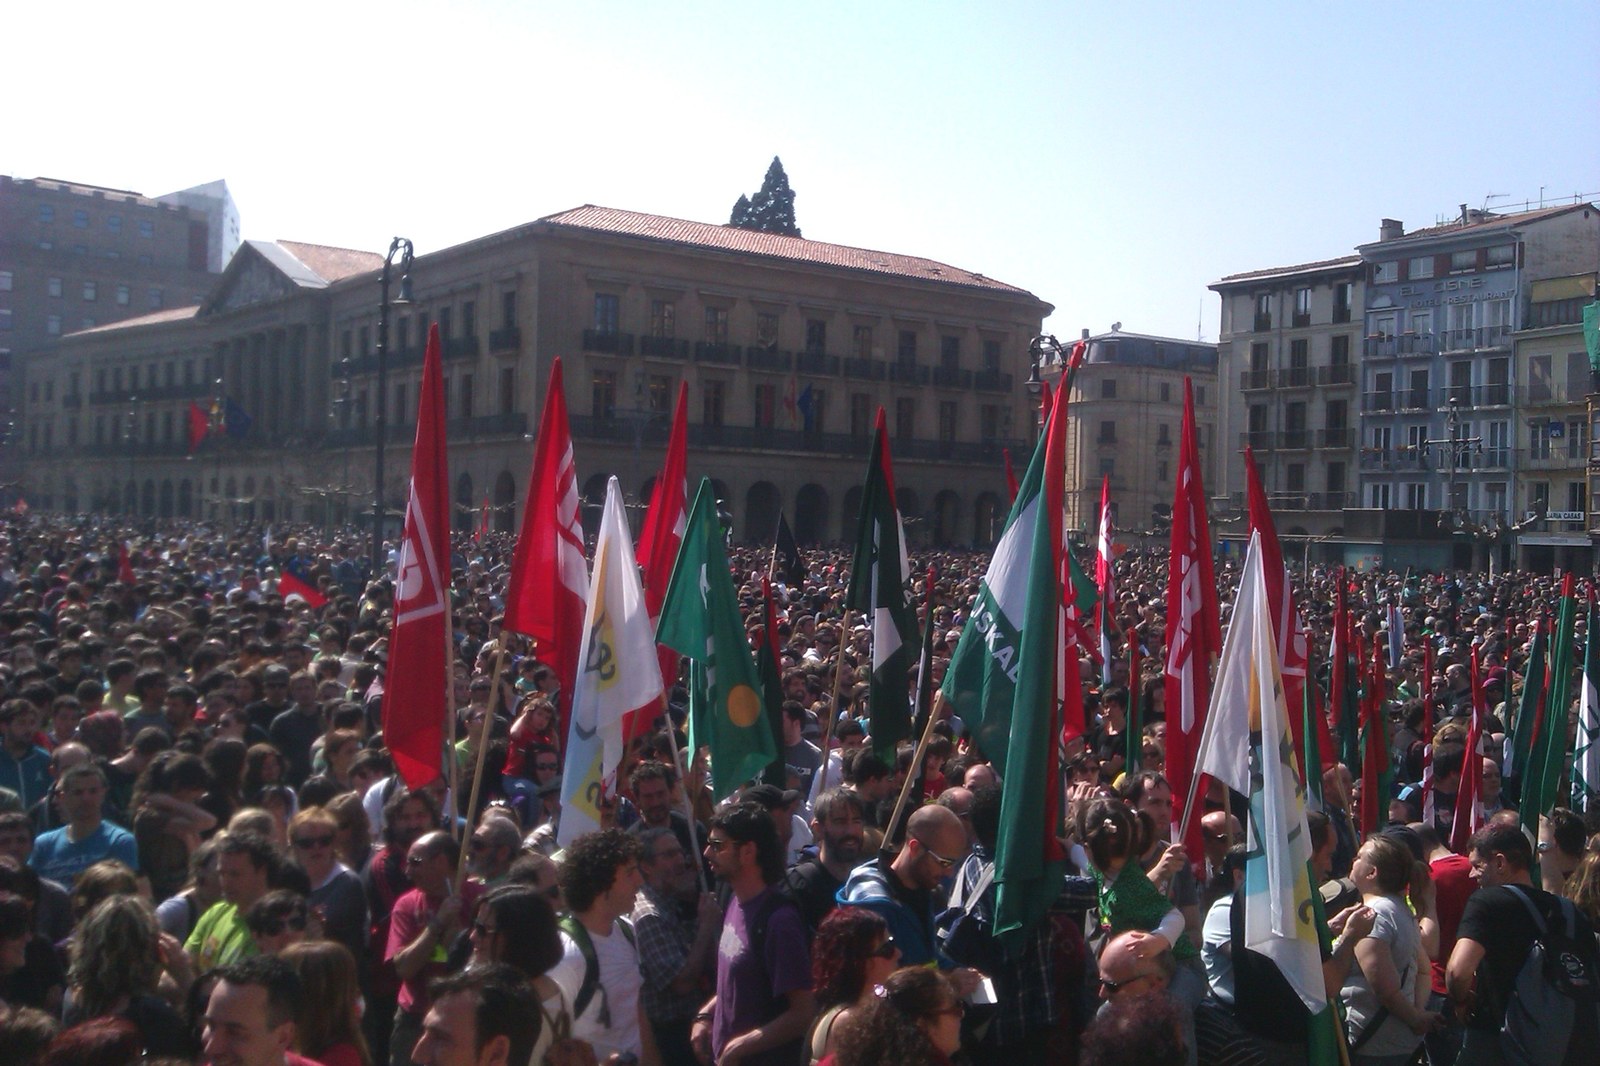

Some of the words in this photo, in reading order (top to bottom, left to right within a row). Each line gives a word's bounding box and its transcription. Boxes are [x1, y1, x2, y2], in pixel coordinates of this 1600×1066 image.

[1400, 286, 1424, 297] EL
[1433, 278, 1482, 293] CISNE
[1563, 512, 1581, 520] CASAS
